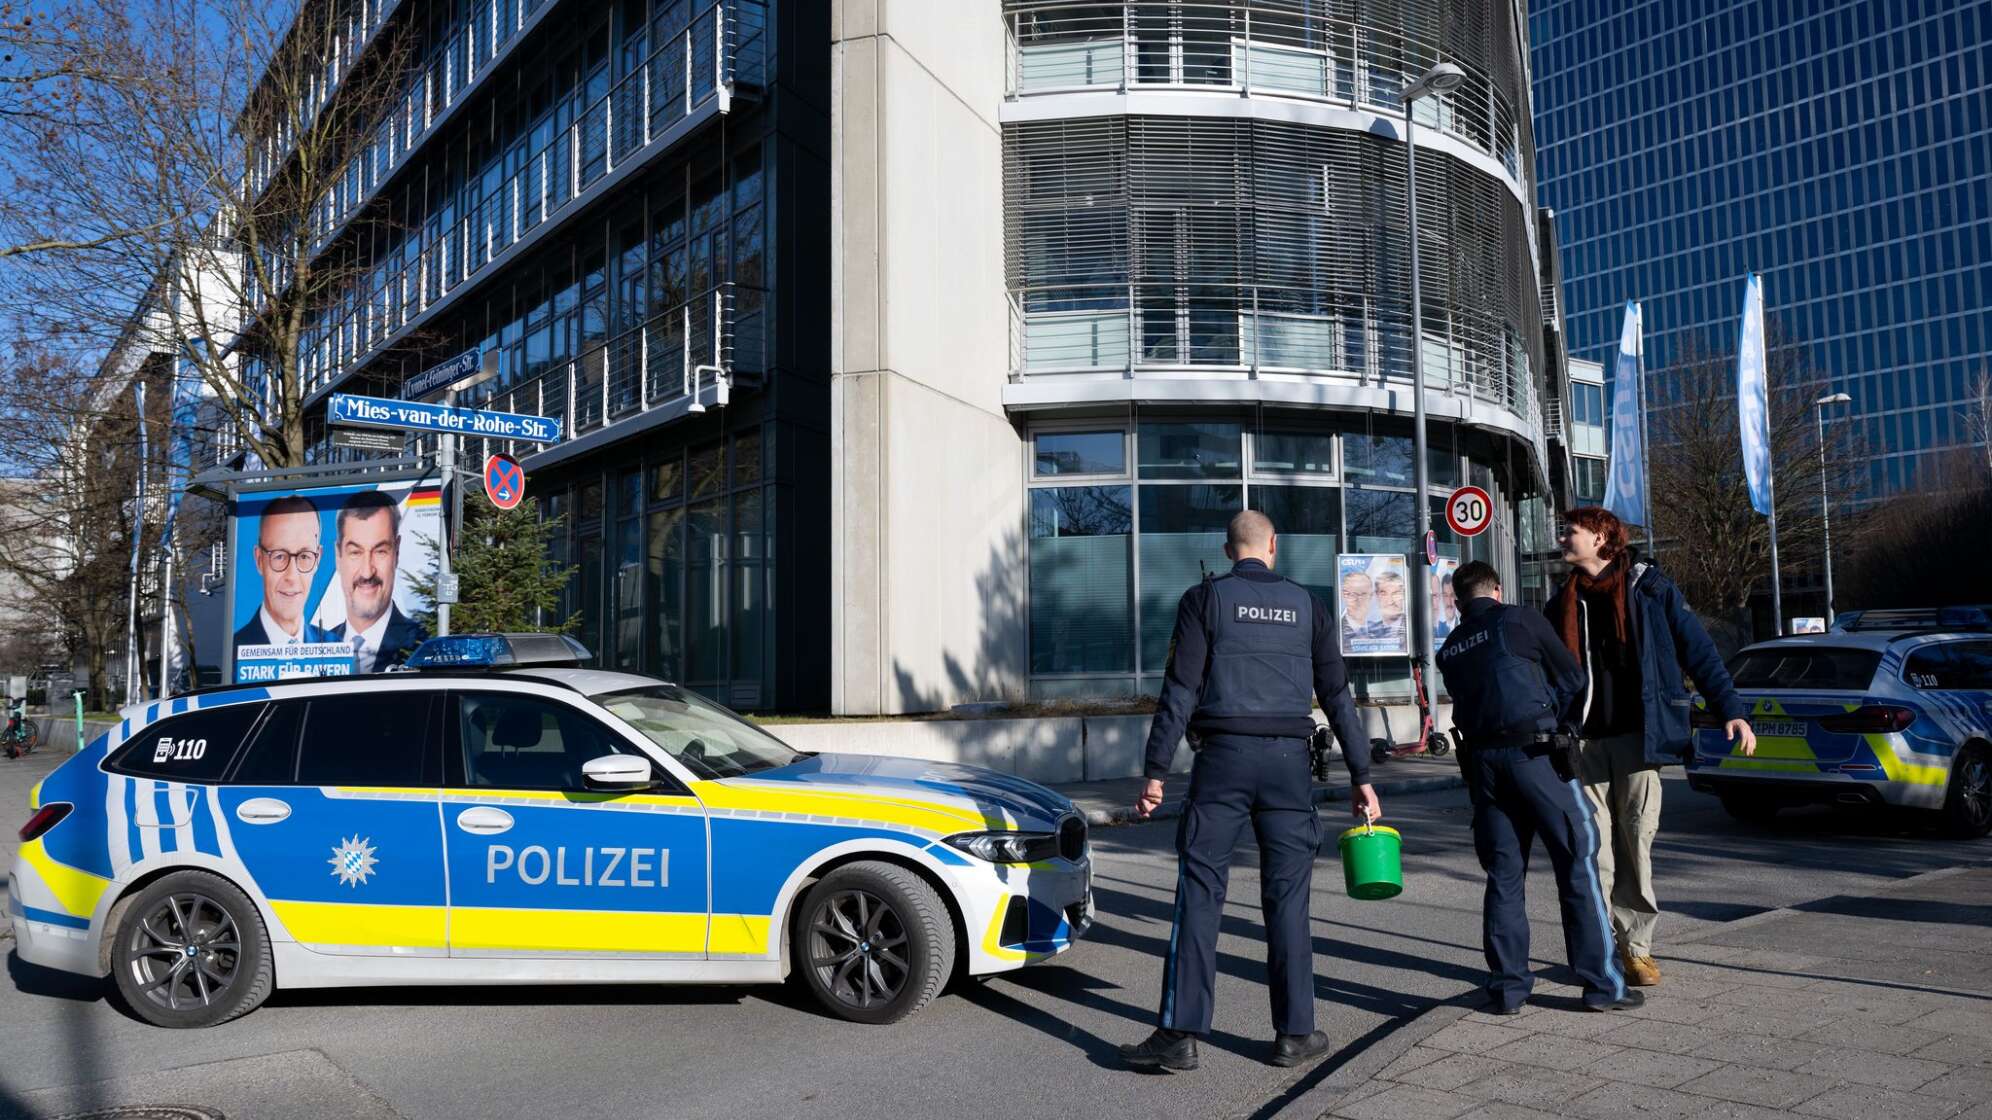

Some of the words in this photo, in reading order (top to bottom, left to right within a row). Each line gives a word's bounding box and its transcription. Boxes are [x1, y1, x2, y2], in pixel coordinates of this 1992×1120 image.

[346, 399, 549, 438] Mies-van-der-Rohe-Str.
[1456, 500, 1482, 523] 30
[1238, 606, 1297, 623] POLIZEI
[240, 647, 283, 658] GEMEINSAM
[285, 645, 299, 656] FÜR
[300, 645, 351, 657] DEUTSCHLAND
[1442, 629, 1489, 662] POLIZEI
[239, 665, 276, 681] STARK
[278, 662, 301, 678] FÜR
[1921, 674, 1939, 687] 110
[1777, 722, 1806, 735] 8785
[173, 739, 207, 760] 110
[486, 844, 670, 888] POLIZEI
